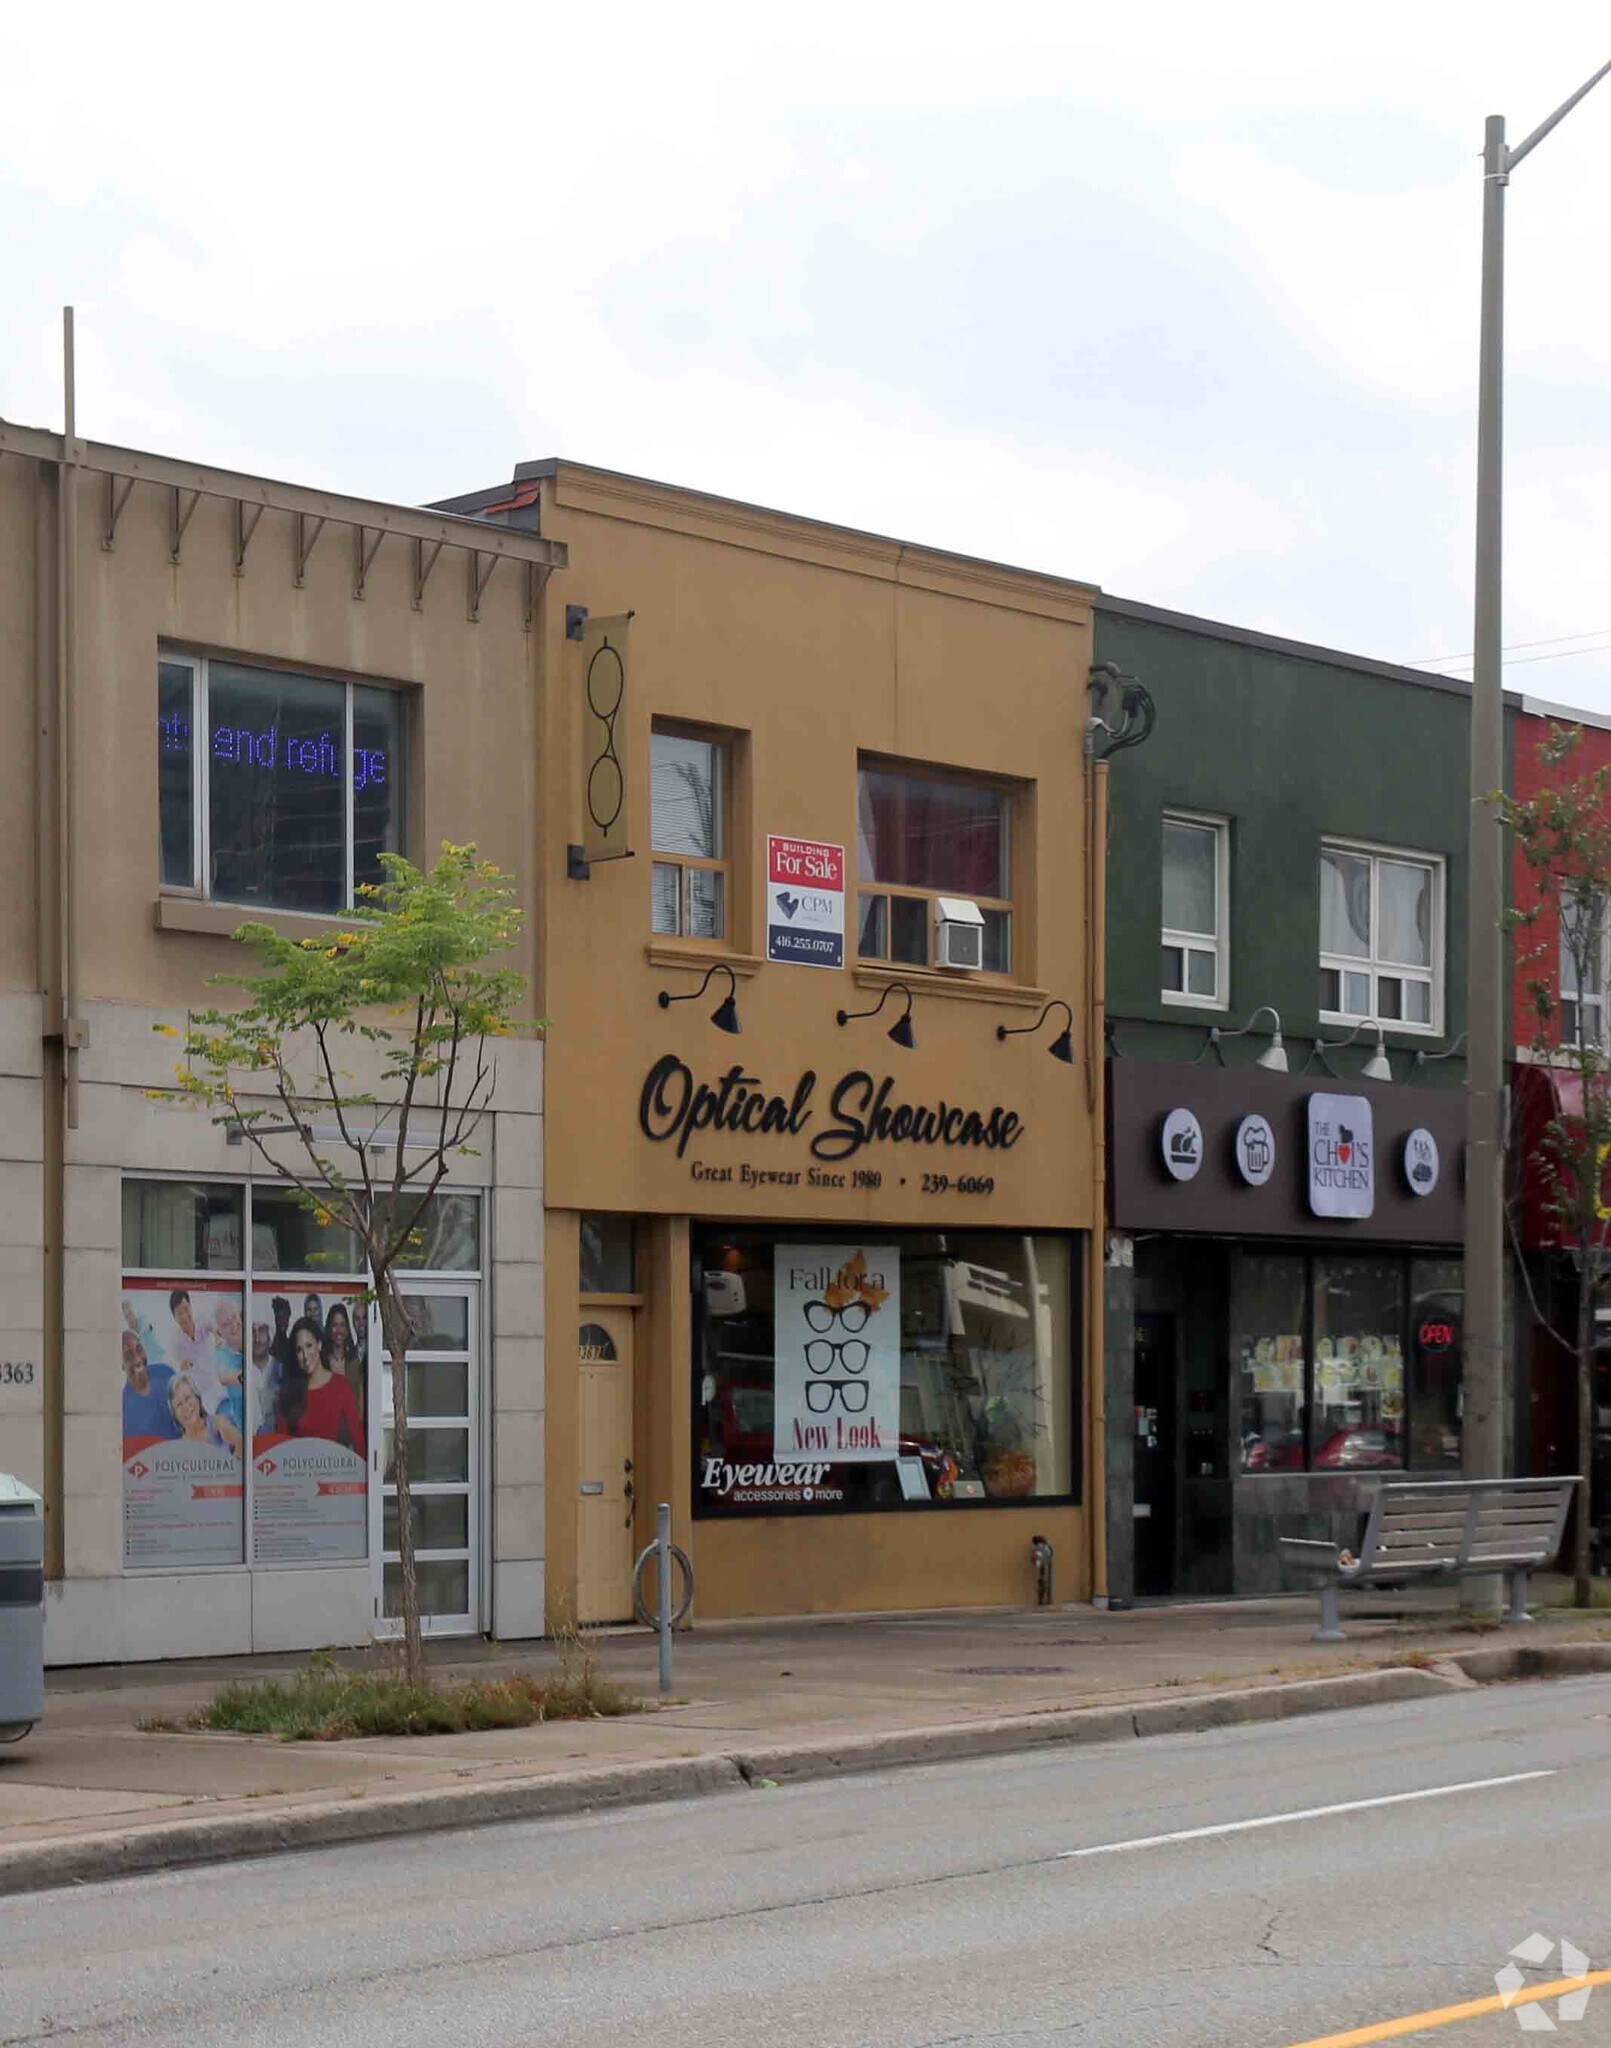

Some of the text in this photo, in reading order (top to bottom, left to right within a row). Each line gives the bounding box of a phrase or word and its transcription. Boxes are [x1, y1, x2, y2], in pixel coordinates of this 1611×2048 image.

[783, 842, 830, 857] BUILDING
[776, 851, 838, 880] For Sale
[801, 895, 832, 914] CPM
[640, 1054, 1025, 1161] Optical Showcase
[1315, 1121, 1330, 1137] THE
[691, 1161, 994, 1196] Great Eyewear Since 1980 239-6069
[1314, 1167, 1369, 1189] KITCHEN
[790, 1266, 831, 1291] Fall
[1418, 1323, 1453, 1345] OPEN
[0, 1362, 34, 1384] 363
[792, 1415, 882, 1451] New Look
[155, 1457, 235, 1473] POLYCULTURAL
[283, 1455, 358, 1470] POLYCULTURAL
[701, 1457, 832, 1496] Eyewear
[734, 1488, 843, 1502] accessories more
